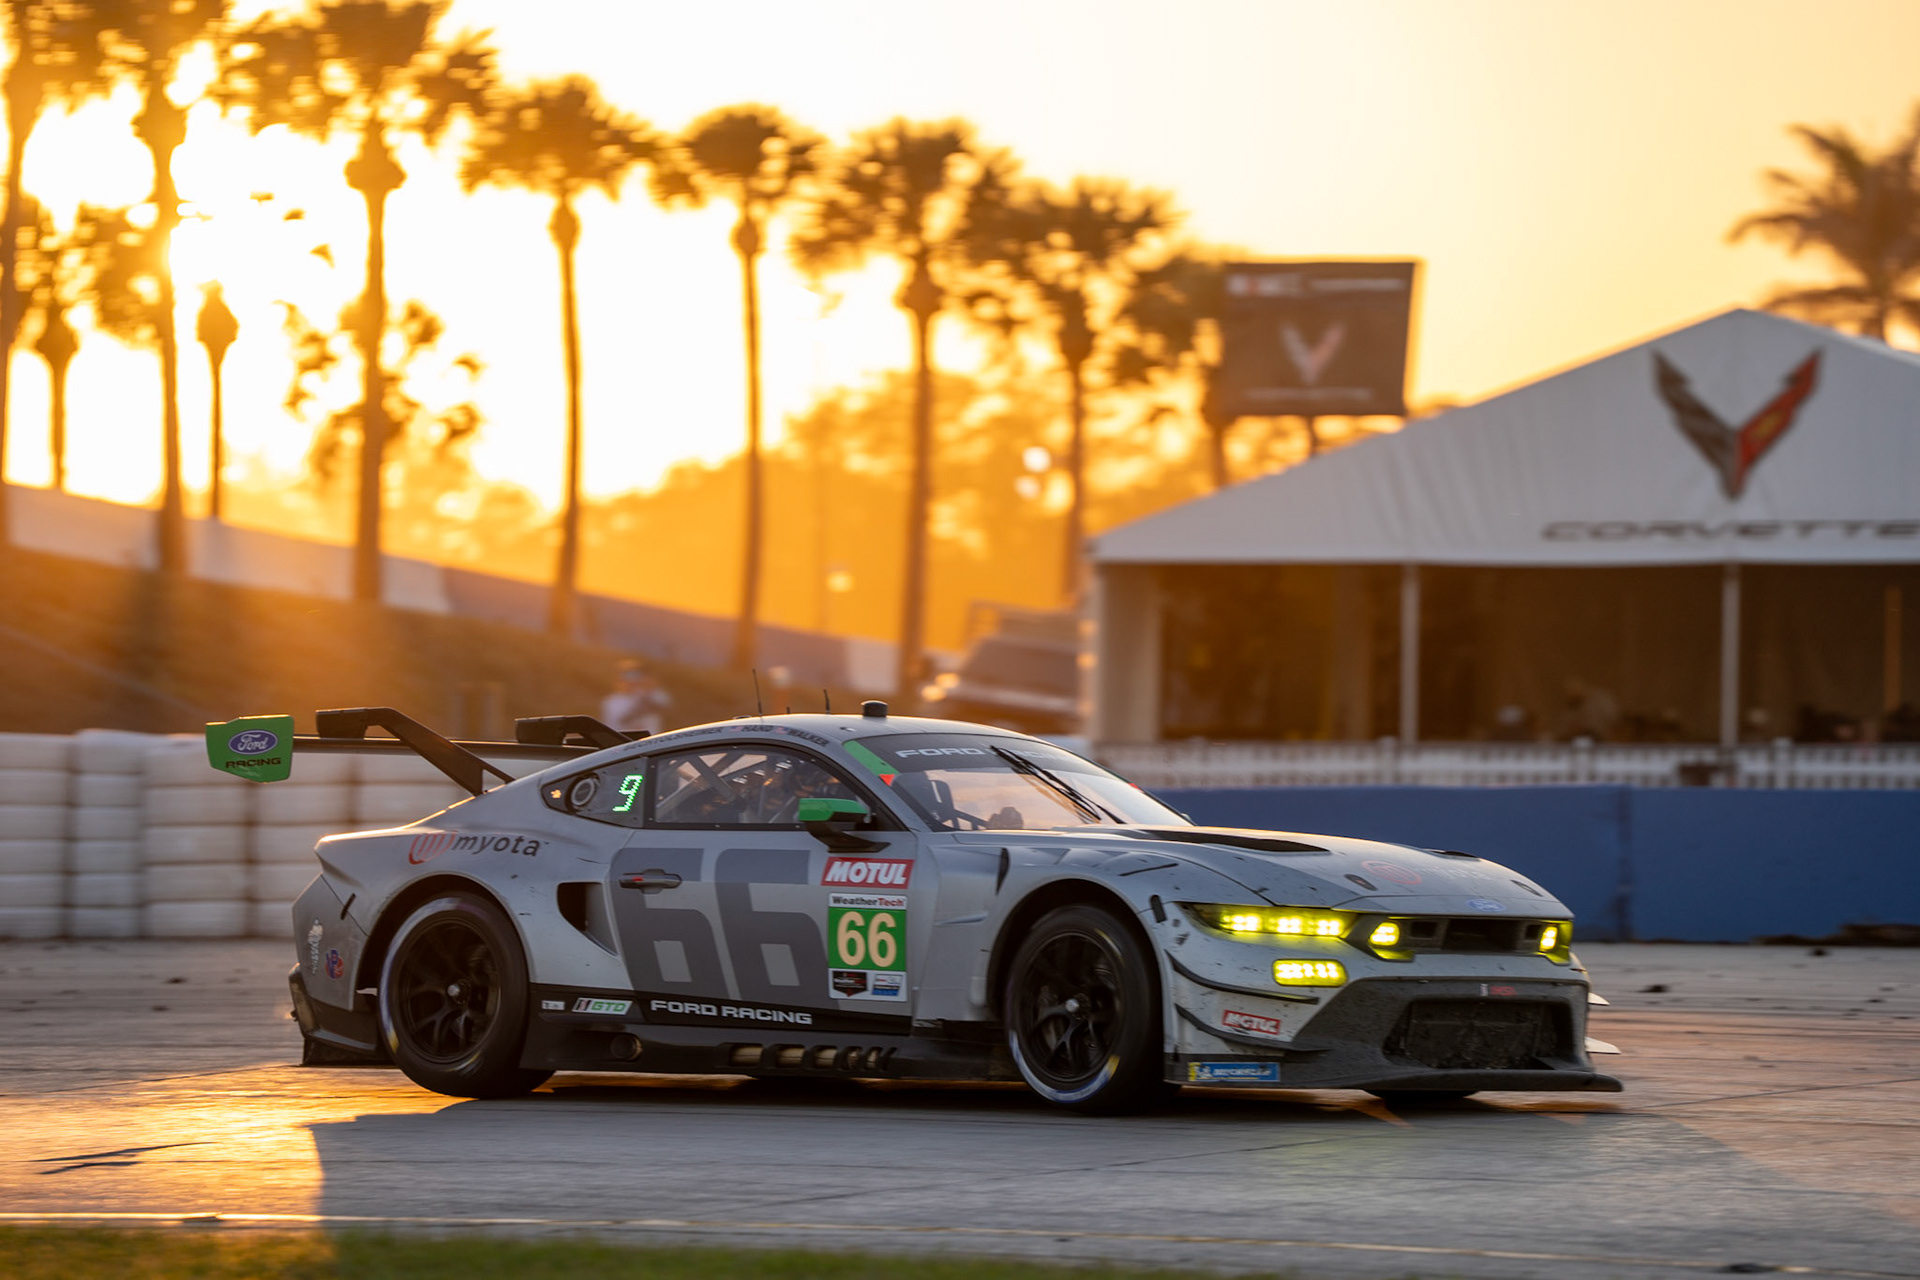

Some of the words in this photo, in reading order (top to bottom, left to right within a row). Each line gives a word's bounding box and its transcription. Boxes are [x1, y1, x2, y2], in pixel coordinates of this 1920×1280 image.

[1542, 519, 1920, 541] CORVETTE
[237, 733, 269, 751] Ford
[895, 748, 986, 758] FORD
[225, 757, 282, 769] RACING
[612, 775, 643, 812] 9
[452, 834, 542, 858] myota
[825, 861, 907, 885] MOTUL
[832, 896, 905, 907] WeatherTech
[609, 848, 840, 1011] 66
[837, 911, 897, 968] 66
[591, 1001, 627, 1012] GTD
[651, 1000, 718, 1016] FORD
[721, 1005, 813, 1025] RACING
